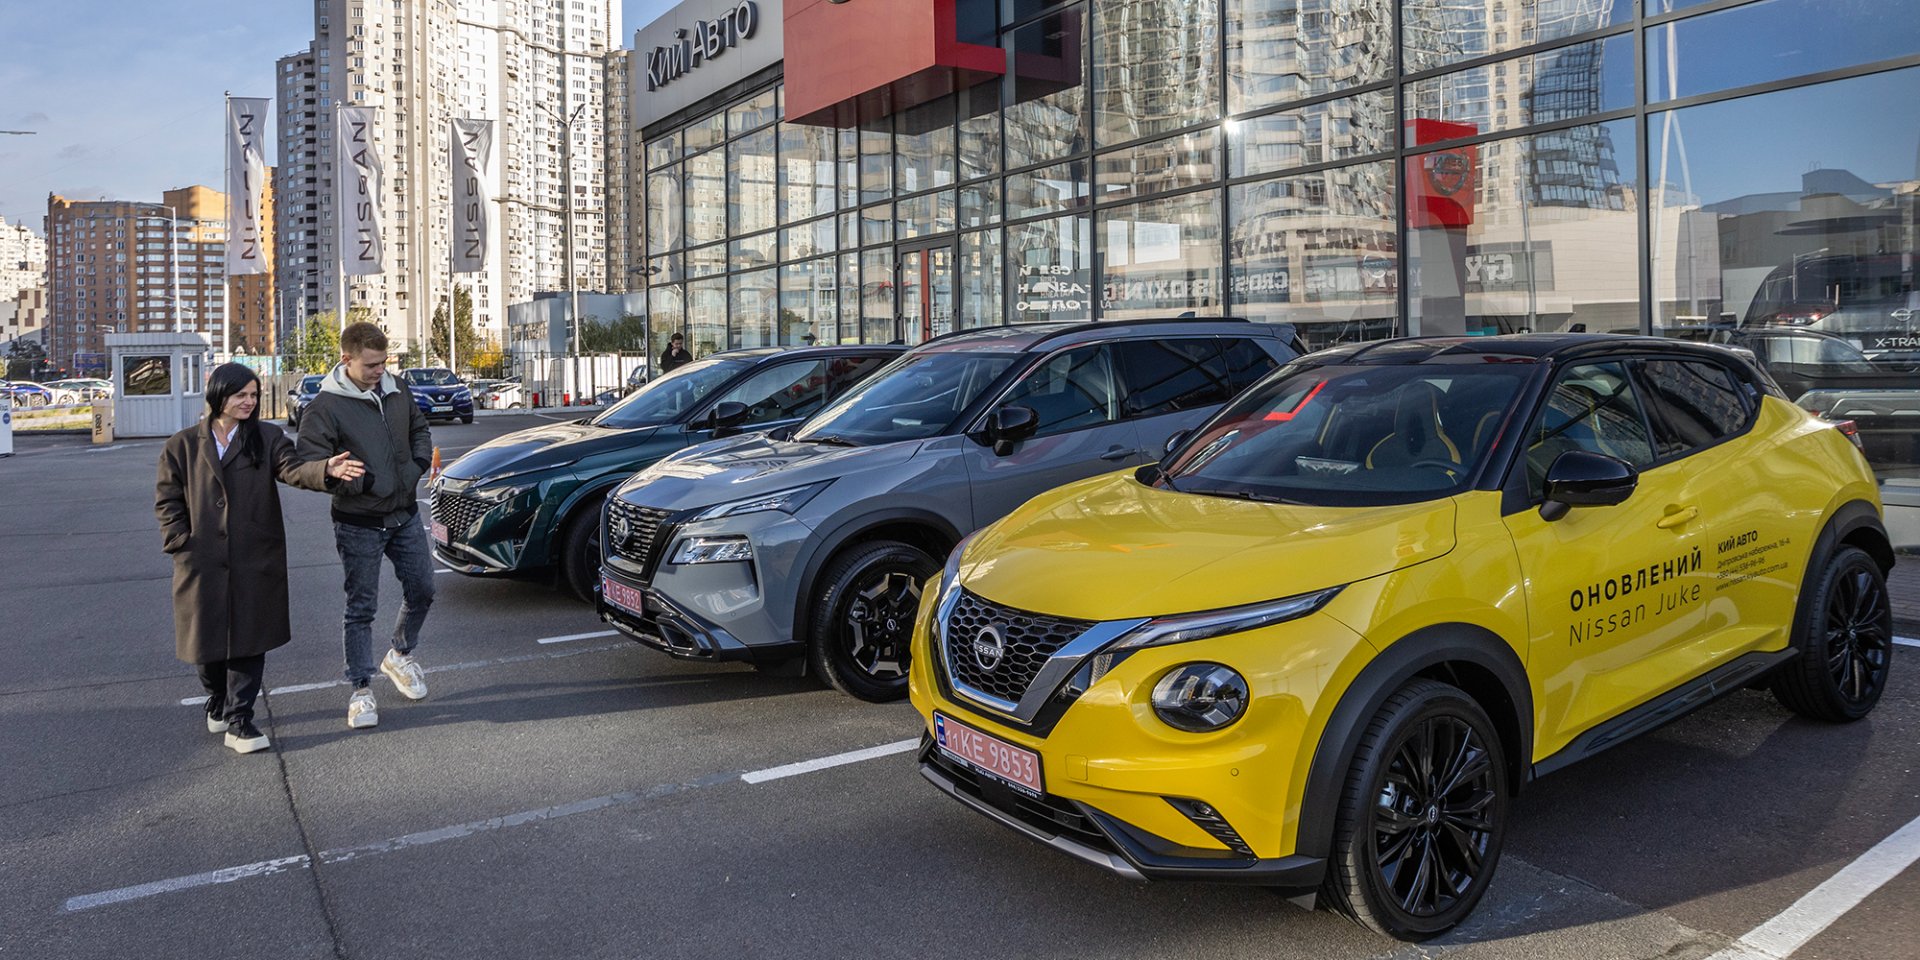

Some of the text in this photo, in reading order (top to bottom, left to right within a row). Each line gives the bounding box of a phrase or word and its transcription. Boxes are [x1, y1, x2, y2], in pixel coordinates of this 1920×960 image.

[352, 122, 375, 261] NISSAN
[462, 131, 480, 260] NISSAN
[1717, 530, 1758, 554] КИЙ АВТО
[1570, 545, 1701, 612] ОНОВЛЕНИЙ
[1569, 584, 1701, 647] Nissan Juke
[989, 742, 1034, 783] 9853
